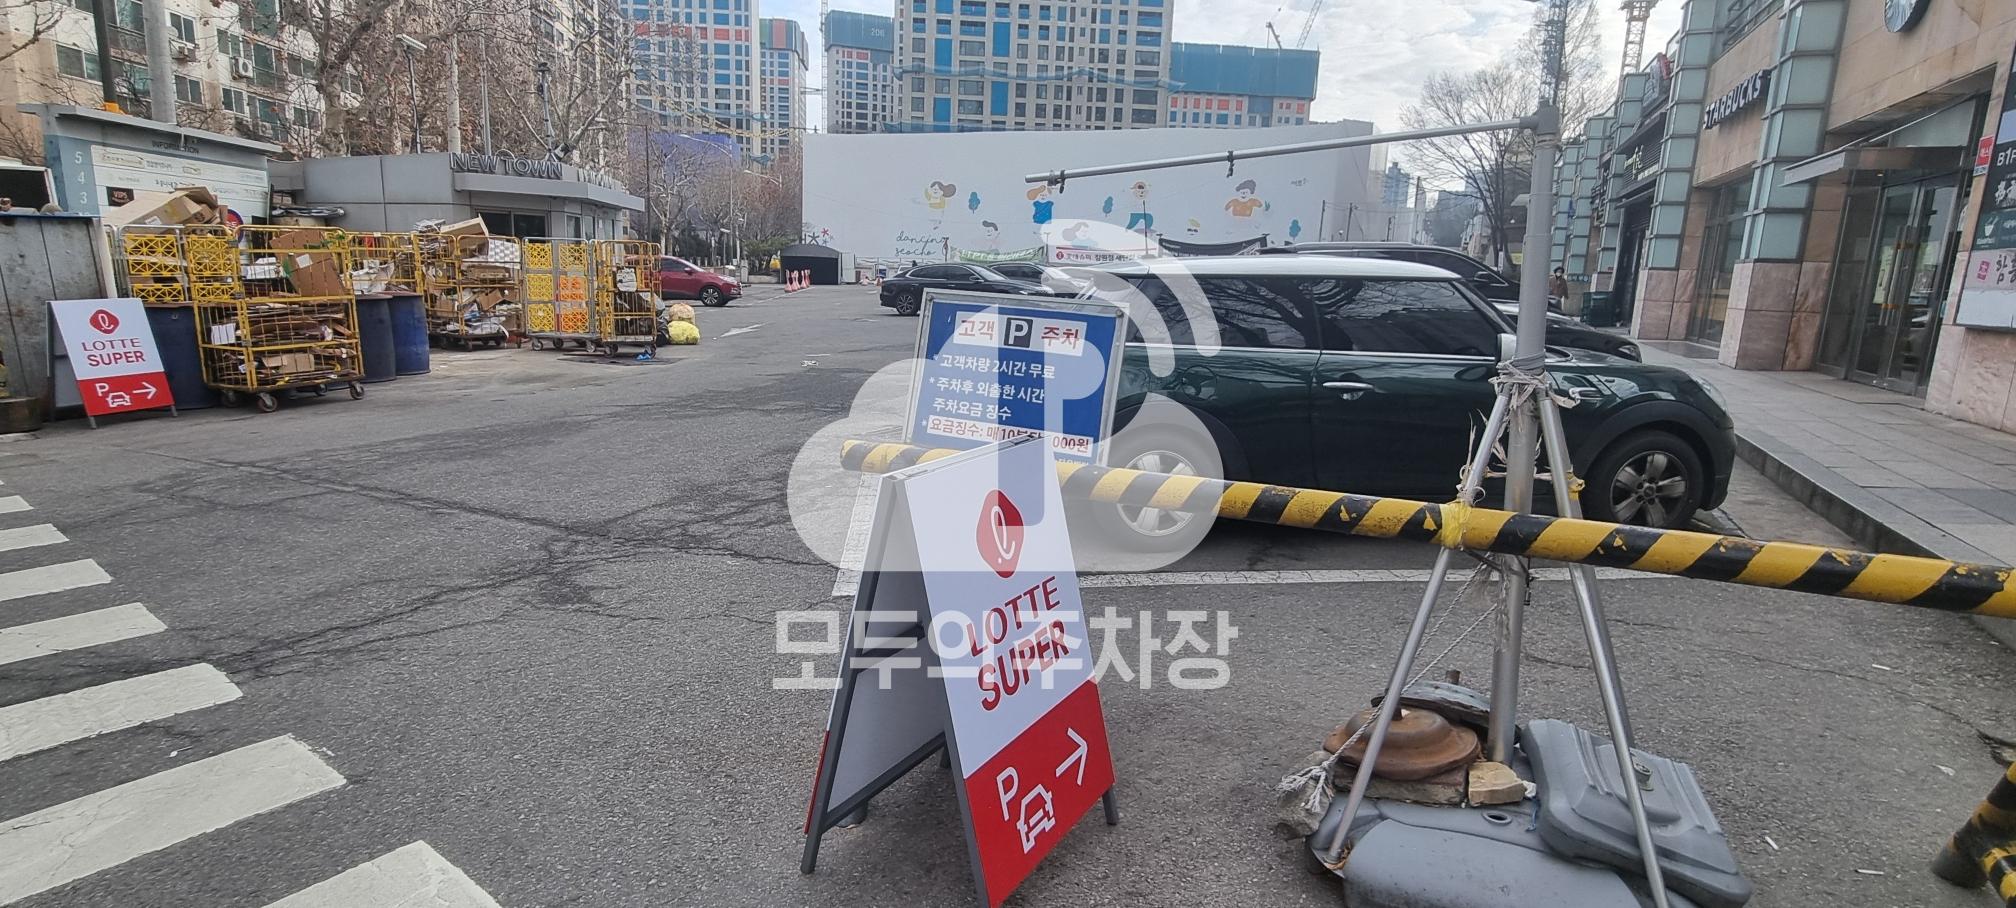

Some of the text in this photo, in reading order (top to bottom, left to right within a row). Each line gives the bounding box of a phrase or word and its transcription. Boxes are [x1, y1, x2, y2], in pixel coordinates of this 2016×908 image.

[1703, 70, 1764, 129] STARBUCKS
[74, 151, 83, 165] 5
[450, 152, 499, 174] NEW
[504, 158, 563, 181] TOWN
[77, 171, 85, 185] 4
[80, 191, 88, 204] 3
[82, 338, 143, 352] LOTTE
[958, 319, 1080, 350] 고객 P 주차
[87, 350, 146, 367] SUPER
[940, 353, 1056, 379] 고객차량 2시간 무료
[95, 382, 109, 397] P
[936, 377, 1045, 404] 주차후 외출한 시간
[932, 397, 1012, 421] 주차요금 징수
[929, 418, 984, 437] 요금징수:
[965, 575, 1061, 657] LOTTE
[977, 619, 1070, 712] SUPER
[996, 766, 1020, 821] P
